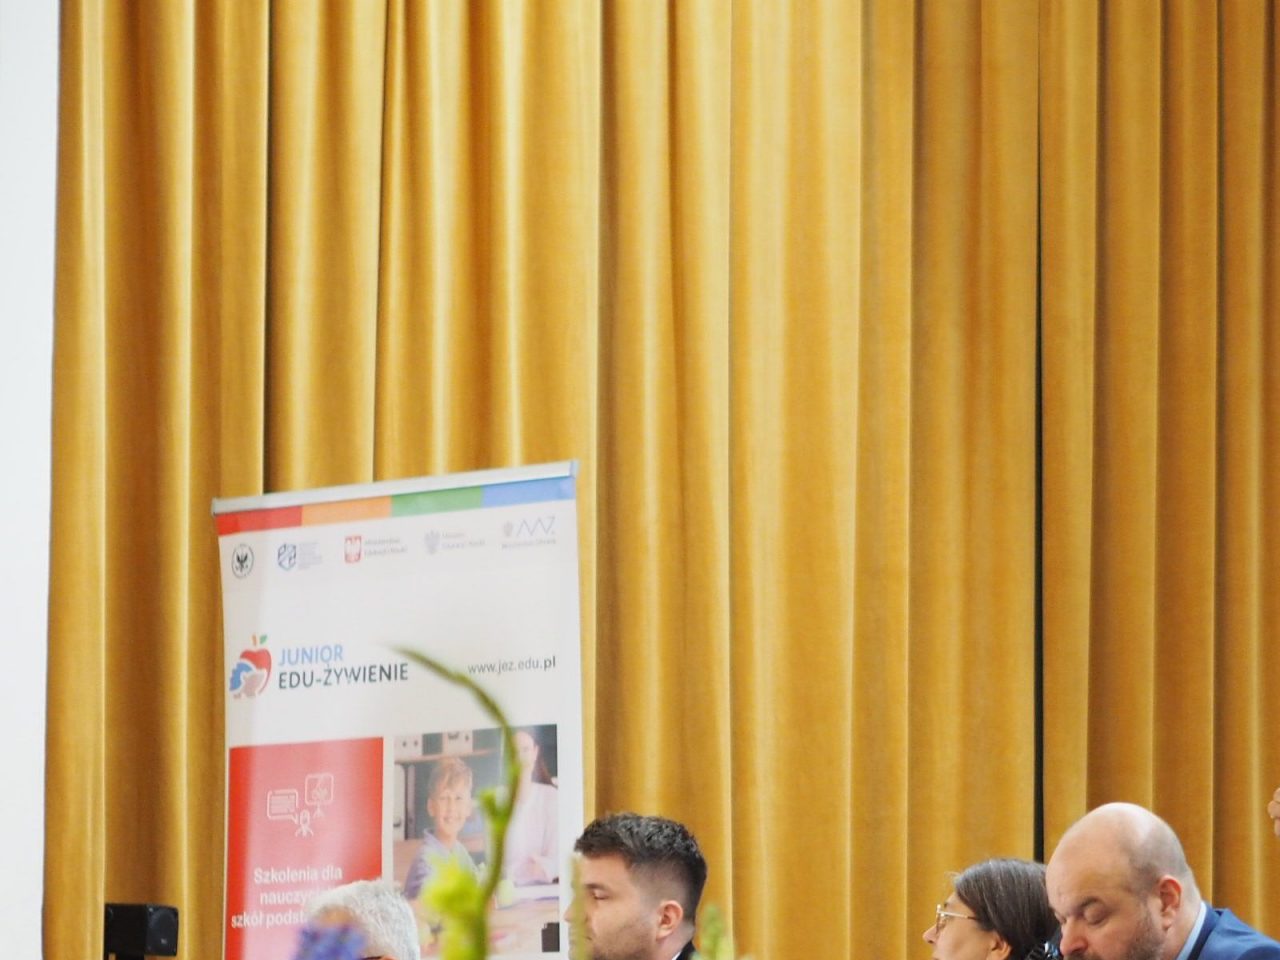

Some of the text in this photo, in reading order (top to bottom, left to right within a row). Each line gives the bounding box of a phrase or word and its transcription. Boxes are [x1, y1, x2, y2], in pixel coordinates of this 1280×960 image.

[278, 644, 343, 667] JUNIOR
[278, 663, 409, 689] EDU-ŻYWIENIE
[253, 864, 343, 884] Szkolenia dla
